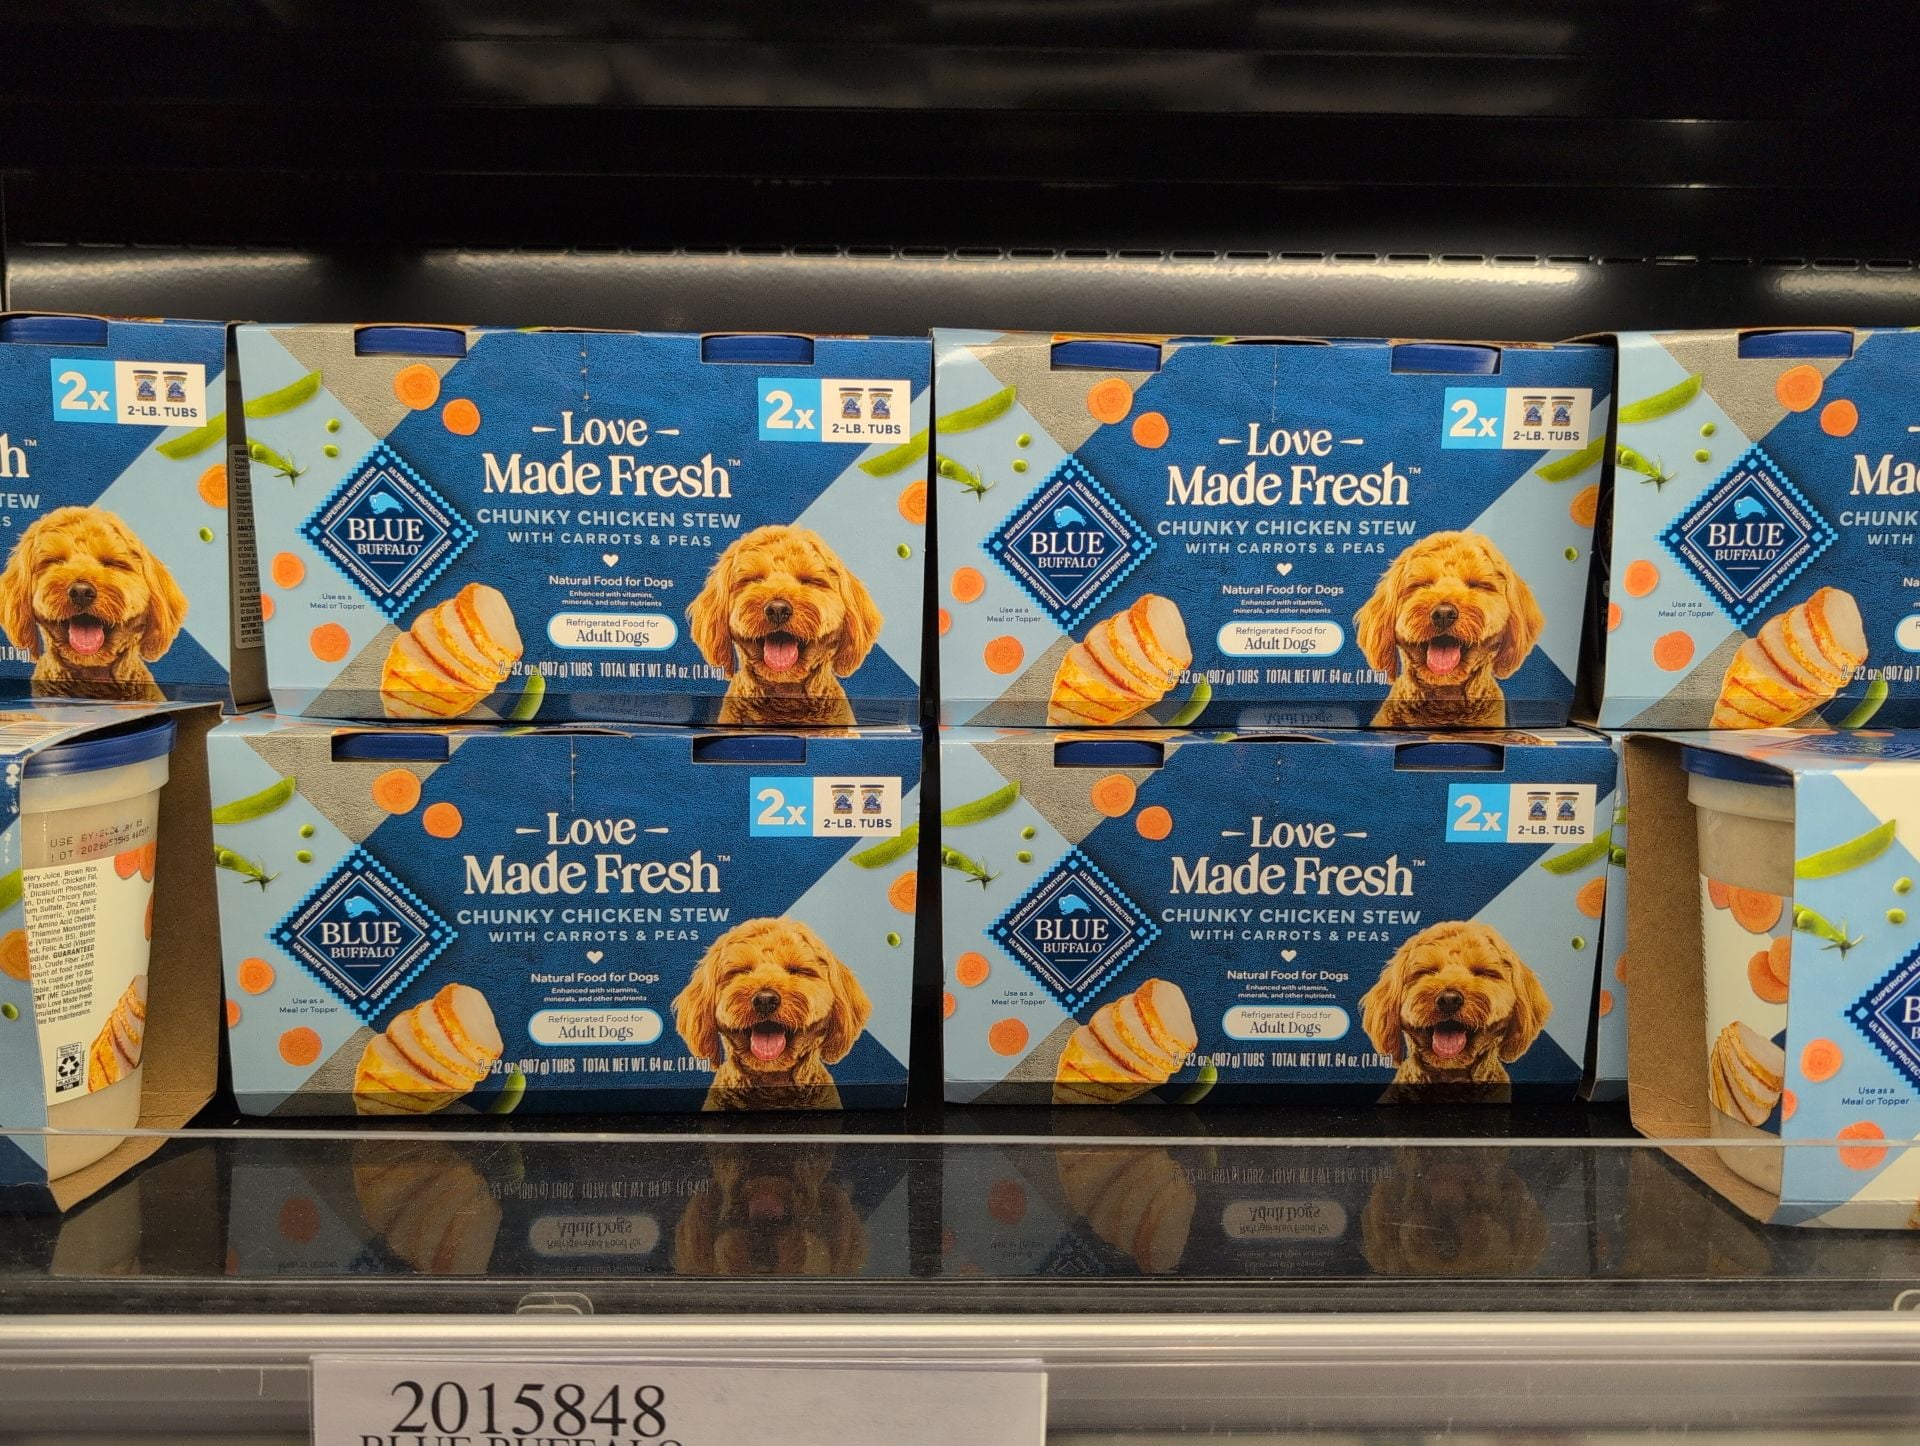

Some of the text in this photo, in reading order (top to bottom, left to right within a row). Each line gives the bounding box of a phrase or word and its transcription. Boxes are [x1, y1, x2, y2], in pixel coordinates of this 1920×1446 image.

[59, 370, 110, 411] 2x
[128, 406, 197, 417] 2-LB. TUBS
[765, 390, 815, 429] 2x
[1450, 399, 1498, 437] 2x
[561, 411, 648, 446] Love
[832, 424, 901, 434] 2-LB. TUBS
[1513, 431, 1579, 440] 2-LB. TUBS
[1248, 423, 1332, 456] Love
[482, 450, 601, 495] Made
[1166, 461, 1282, 505] Made
[0, 493, 40, 509] TEW
[321, 466, 376, 526] SUPERIOR NUTRITION
[388, 466, 451, 527] ULTIMATE PROTECTION
[477, 508, 741, 528] CHUNKY CHICKEN STEW
[1839, 510, 1920, 526] CHUNK
[347, 518, 424, 541] BLUE
[1157, 521, 1416, 535] CHUNKY CHICKEN STEW
[1707, 523, 1785, 547] BLUE
[508, 532, 711, 546] WITH CARROTS & PEAS
[1030, 532, 1104, 555] BLUE
[1868, 534, 1912, 545] WITH
[357, 544, 419, 555] BUFFALO
[1186, 542, 1385, 554] WITH CARROTS & PEAS
[1714, 549, 1776, 560] BUFFALO
[322, 538, 383, 597] ULTIMATE PROTECTION
[396, 540, 452, 597] SUPERIOR NUTRITION
[1038, 557, 1098, 568] BUFFALO
[549, 575, 673, 589] Natural Food for Dogs
[1223, 585, 1344, 596] Natural Food for Dogs
[566, 619, 620, 628] Refrigerated
[623, 619, 644, 627] Food
[576, 629, 649, 646] Adult Dogs
[1236, 627, 1288, 636] Refrigerated
[1291, 627, 1312, 635] Food
[1244, 637, 1316, 653] Adult Dogs
[571, 662, 592, 677] TUBS
[601, 662, 626, 677] TOTAL
[629, 663, 645, 678] NET
[648, 663, 663, 677] WT.
[666, 663, 676, 678] 64
[678, 666, 691, 678] oz.
[757, 788, 806, 825] 2x
[1454, 795, 1502, 831] 2x
[547, 813, 636, 845] Love
[824, 819, 892, 828] 2-LB. TUBS
[1518, 826, 1585, 835] 2-LB. TUBS
[1250, 816, 1336, 848] Love
[51, 837, 73, 848] USE
[65, 868, 83, 876] Brown
[463, 850, 587, 895] Made
[1170, 852, 1285, 895] Made
[63, 877, 86, 885] Chicken
[31, 888, 63, 898] Dicalcium
[57, 893, 80, 902] Chicory
[67, 908, 90, 916] Vitamin
[456, 908, 730, 924] CHUNKY CHICKEN STEW
[1162, 909, 1421, 924] CHUNKY CHICKEN STEW
[320, 922, 402, 945] BLUE
[489, 930, 699, 942] WITH CARROTS & PEAS
[1035, 919, 1109, 941] BLUE
[1190, 930, 1389, 941] WITH CARROTS & PEAS
[53, 944, 94, 958] GUARANTEED
[331, 947, 395, 958] BUFFALO
[1043, 943, 1102, 953] BUFFALO
[531, 973, 659, 984] Natural Food for Dogs
[1227, 970, 1349, 982] Natural Food for Dogs
[1871, 971, 1908, 1006] SUPERIOR
[548, 1014, 643, 1024] Refrigerated Food for
[1241, 1012, 1294, 1020] Refrigerated
[558, 1026, 633, 1041] Adult Dogs
[1250, 1022, 1321, 1037] Adult Dogs
[1869, 1020, 1898, 1053] ULTIMATE
[1878, 1098, 1909, 1106] Topper
[391, 1381, 666, 1437] 2015848
